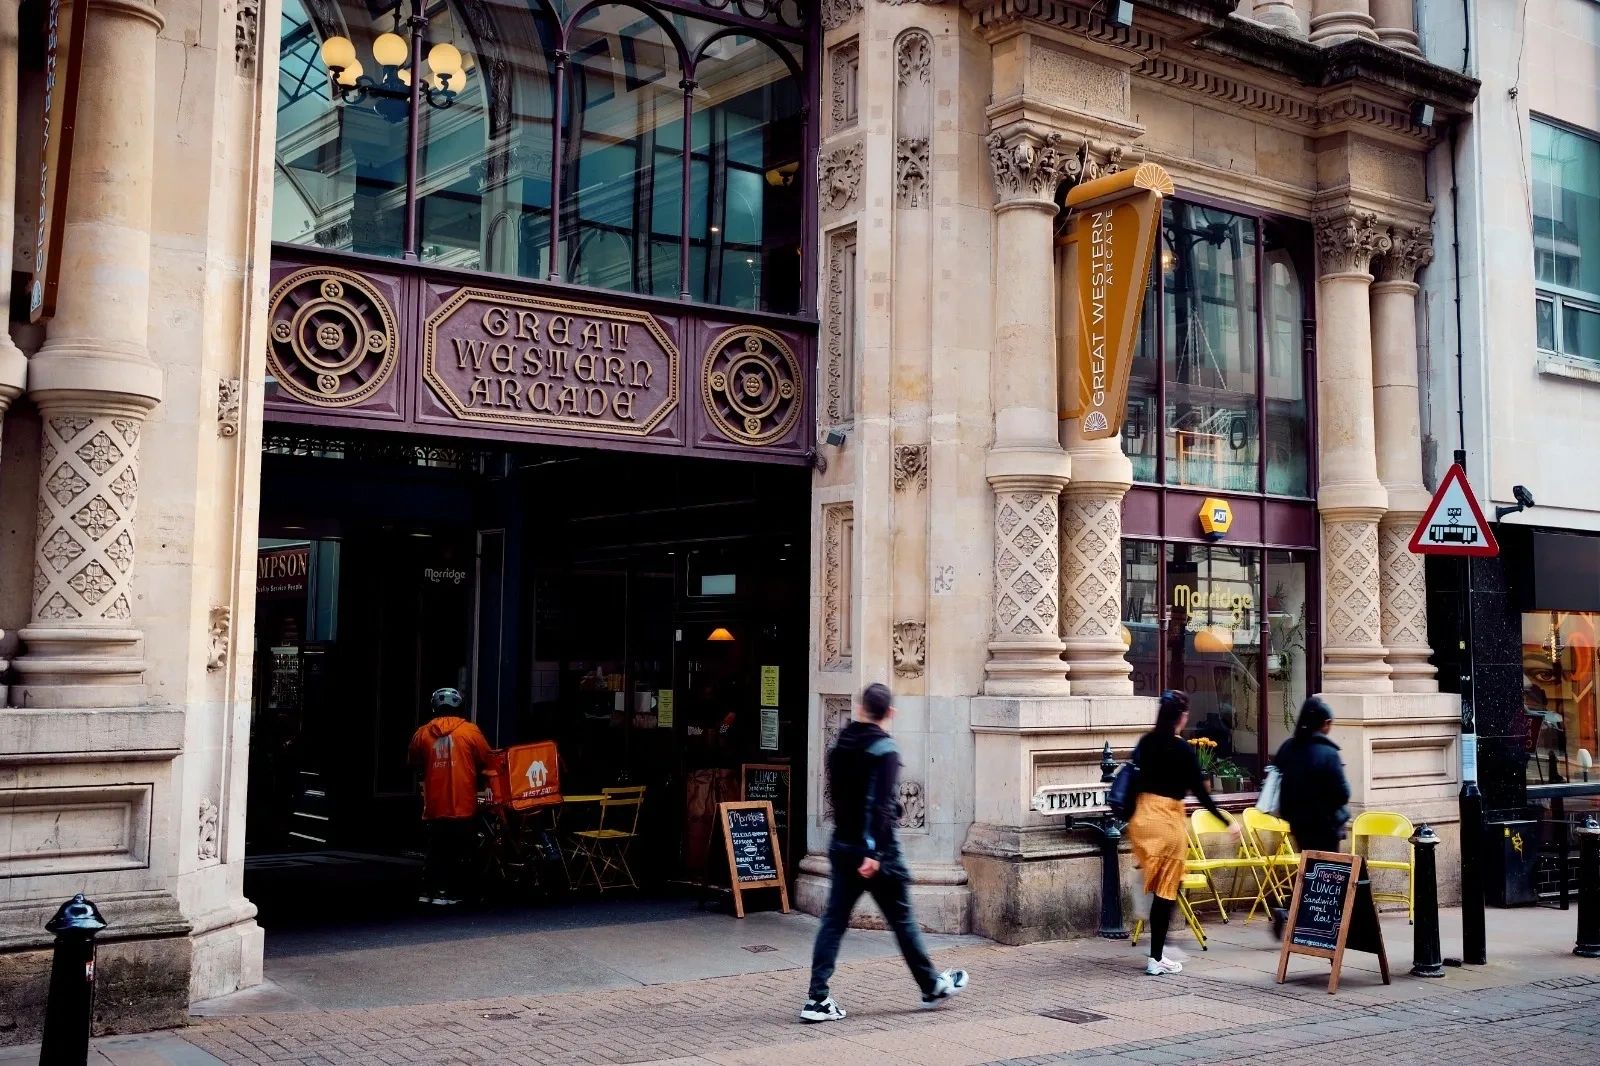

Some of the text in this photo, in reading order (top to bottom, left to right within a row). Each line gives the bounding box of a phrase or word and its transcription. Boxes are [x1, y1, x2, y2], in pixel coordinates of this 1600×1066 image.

[36, 162, 48, 273] GREAT
[1105, 208, 1114, 286] ARCADE
[482, 306, 631, 353] GREAT
[1091, 212, 1105, 407] GREAT WESTERN
[452, 337, 654, 388] WESTERN
[466, 375, 638, 421] ARCADE
[1214, 510, 1226, 522] ADT
[424, 567, 466, 584] Morridge
[1174, 583, 1255, 624] Morridge
[1303, 893, 1338, 907] Sandwich
[1309, 904, 1327, 913] meal
[1310, 880, 1342, 896] LUNCH
[1313, 911, 1331, 923] deal
